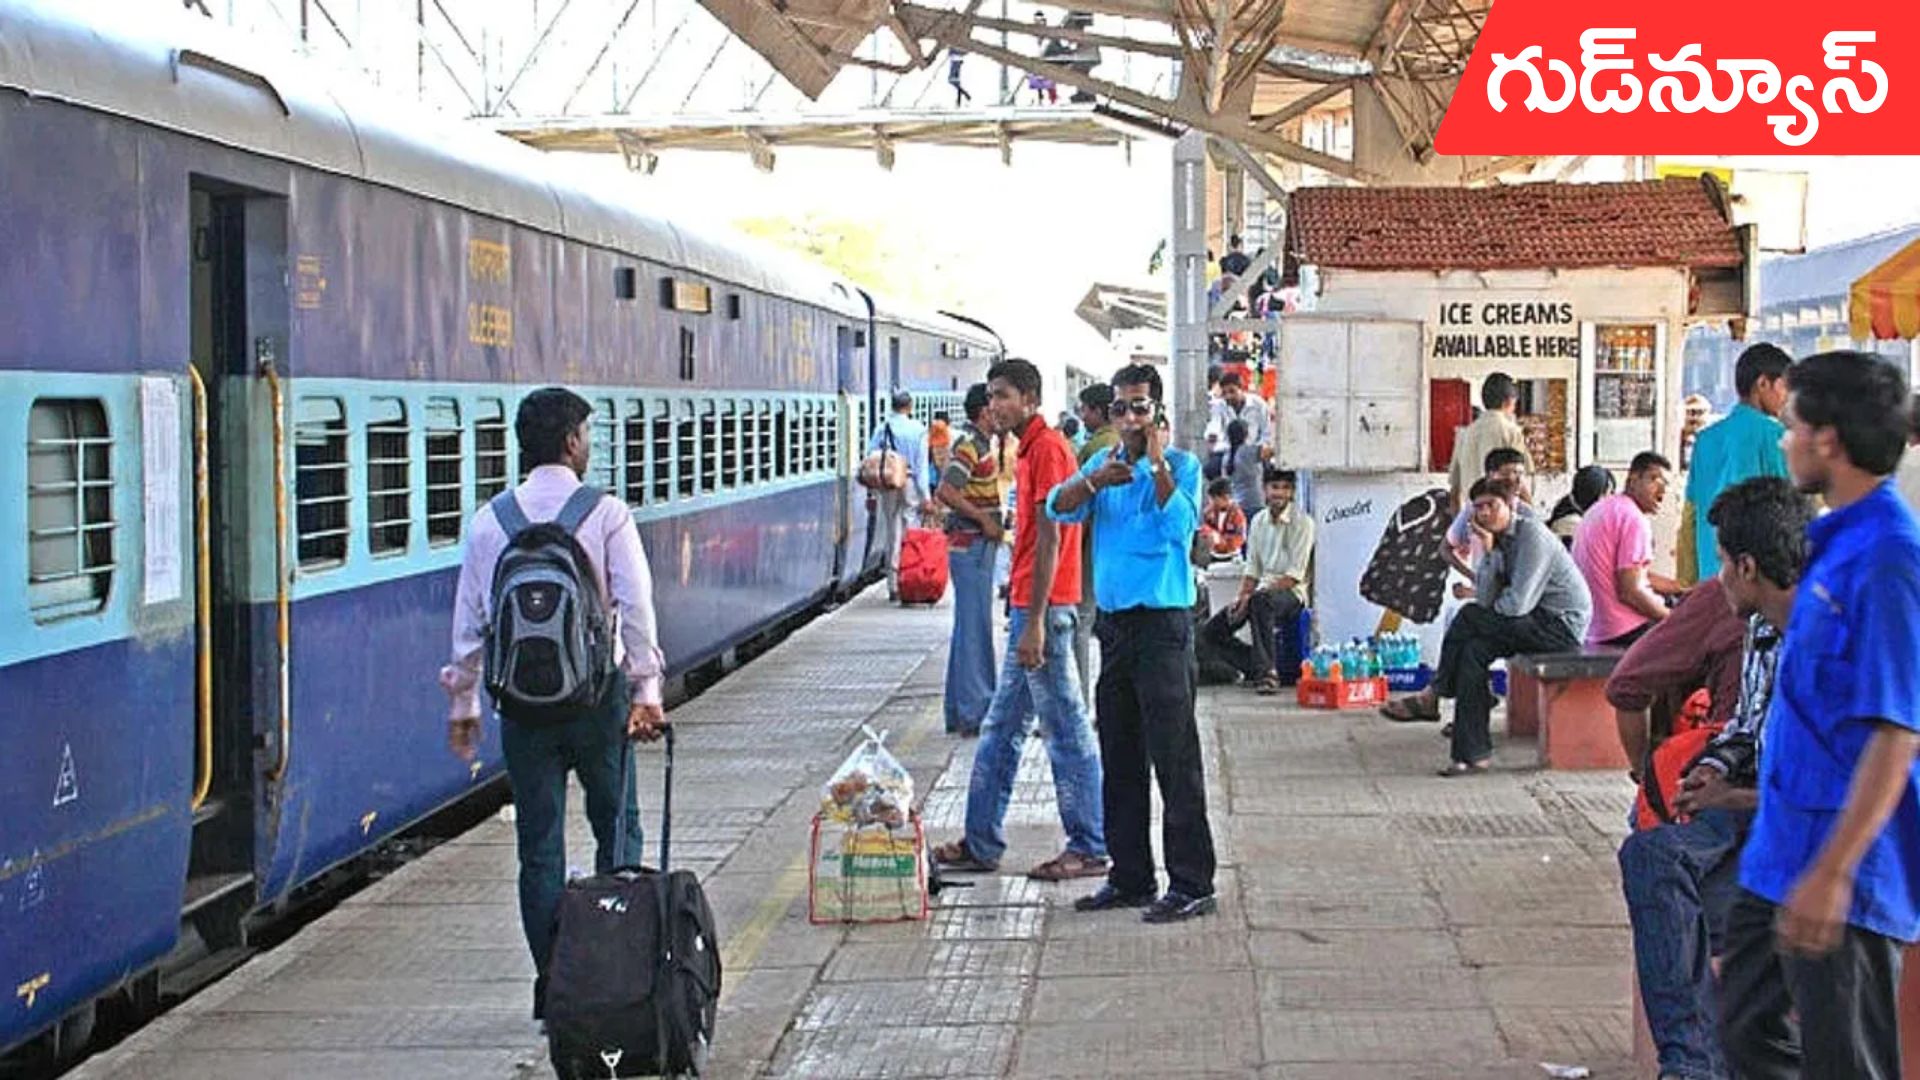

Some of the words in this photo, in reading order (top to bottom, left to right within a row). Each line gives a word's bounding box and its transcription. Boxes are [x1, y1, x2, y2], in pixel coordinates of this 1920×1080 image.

[1440, 303, 1472, 324] ICE
[1482, 303, 1572, 325] CREAMS
[1433, 335, 1531, 357] AVAILABLE
[1535, 336, 1580, 358] HERE
